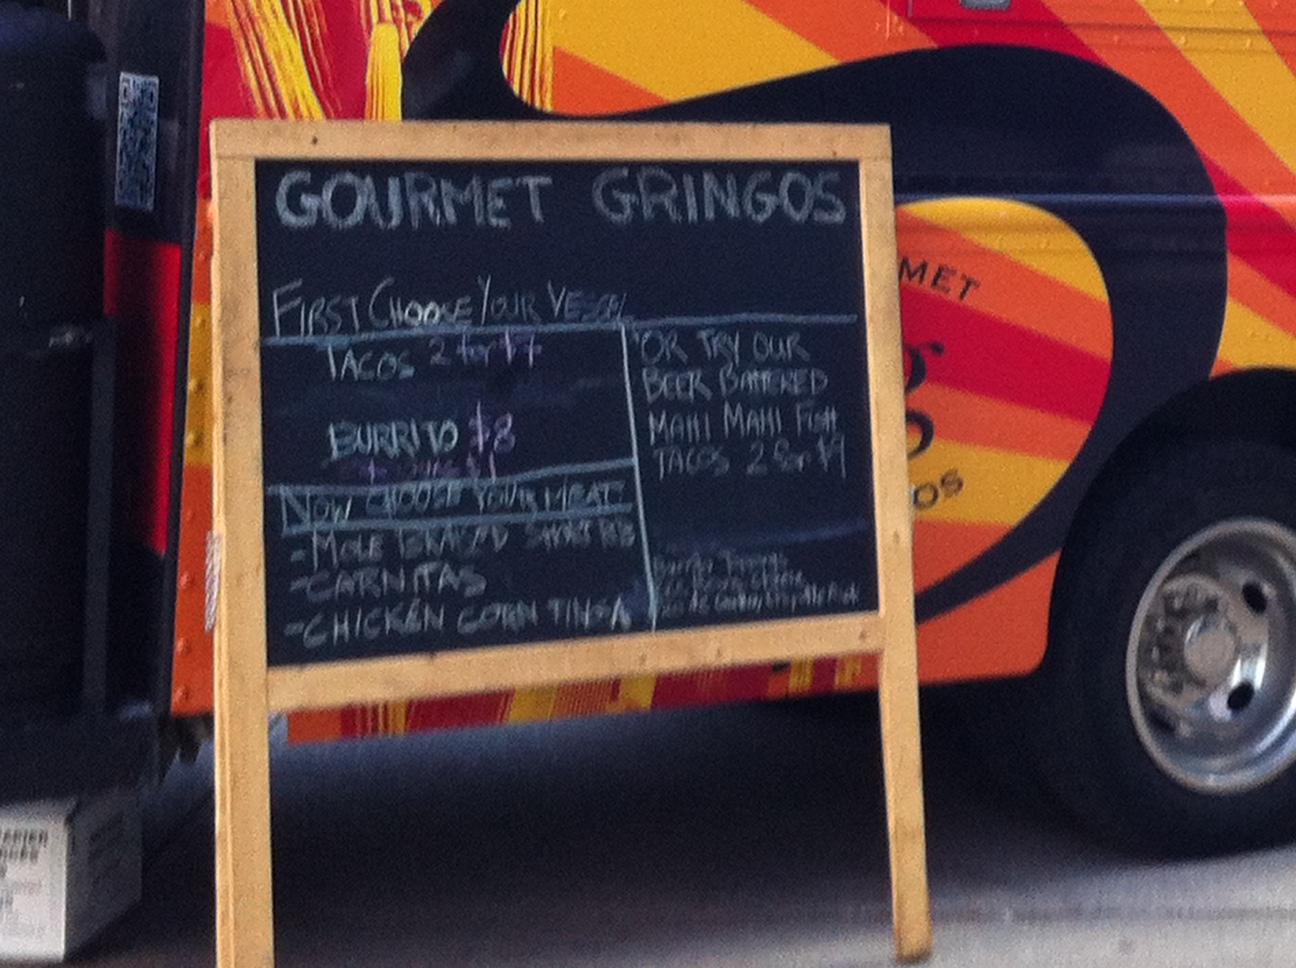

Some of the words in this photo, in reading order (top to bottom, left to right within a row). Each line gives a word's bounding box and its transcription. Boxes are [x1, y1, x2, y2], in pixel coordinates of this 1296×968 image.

[274, 168, 553, 231] GOURMET
[592, 167, 847, 226] GRINGOS
[273, 278, 359, 338] FIRST
[478, 274, 541, 326] YOUR
[326, 345, 416, 382] TACOS
[752, 330, 811, 363] OUR
[328, 419, 459, 461] BURRITO
